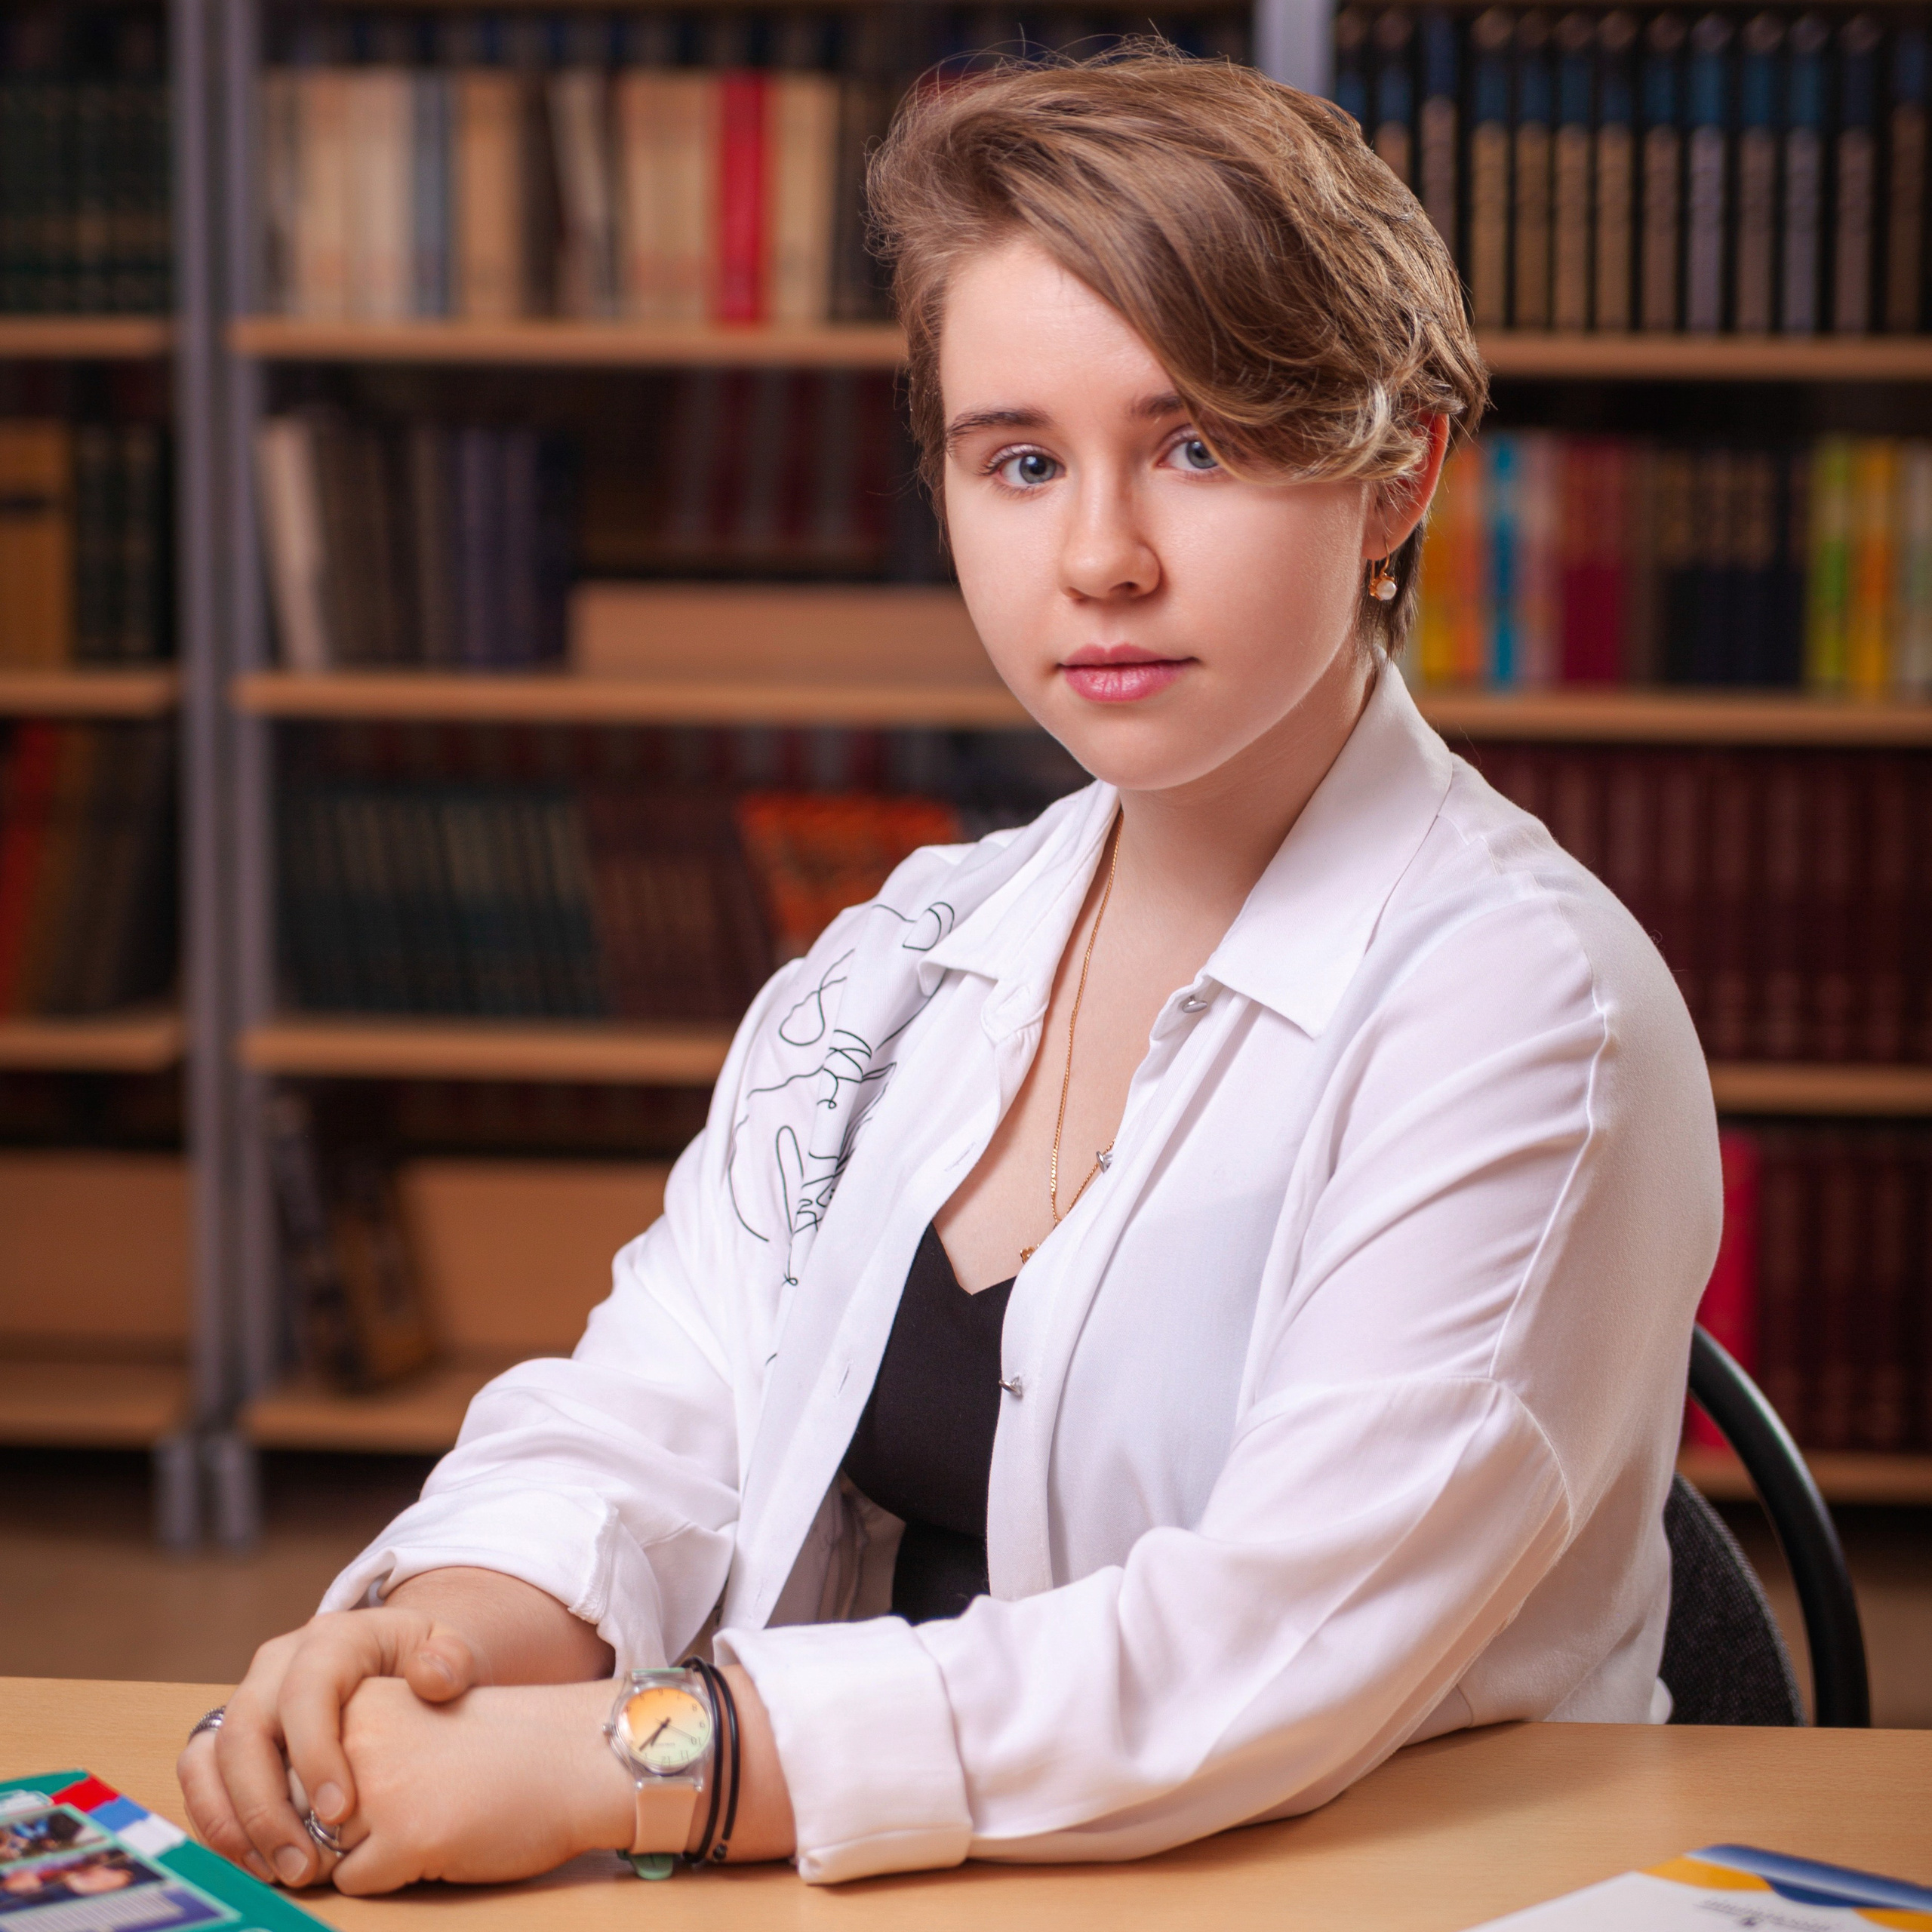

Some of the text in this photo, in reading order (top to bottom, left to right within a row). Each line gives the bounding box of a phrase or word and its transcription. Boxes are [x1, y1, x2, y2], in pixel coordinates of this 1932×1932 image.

[699, 1721, 706, 1729] 9
[691, 1736, 702, 1747] 10
[680, 1750, 690, 1761] 11
[661, 1756, 671, 1766] 12
